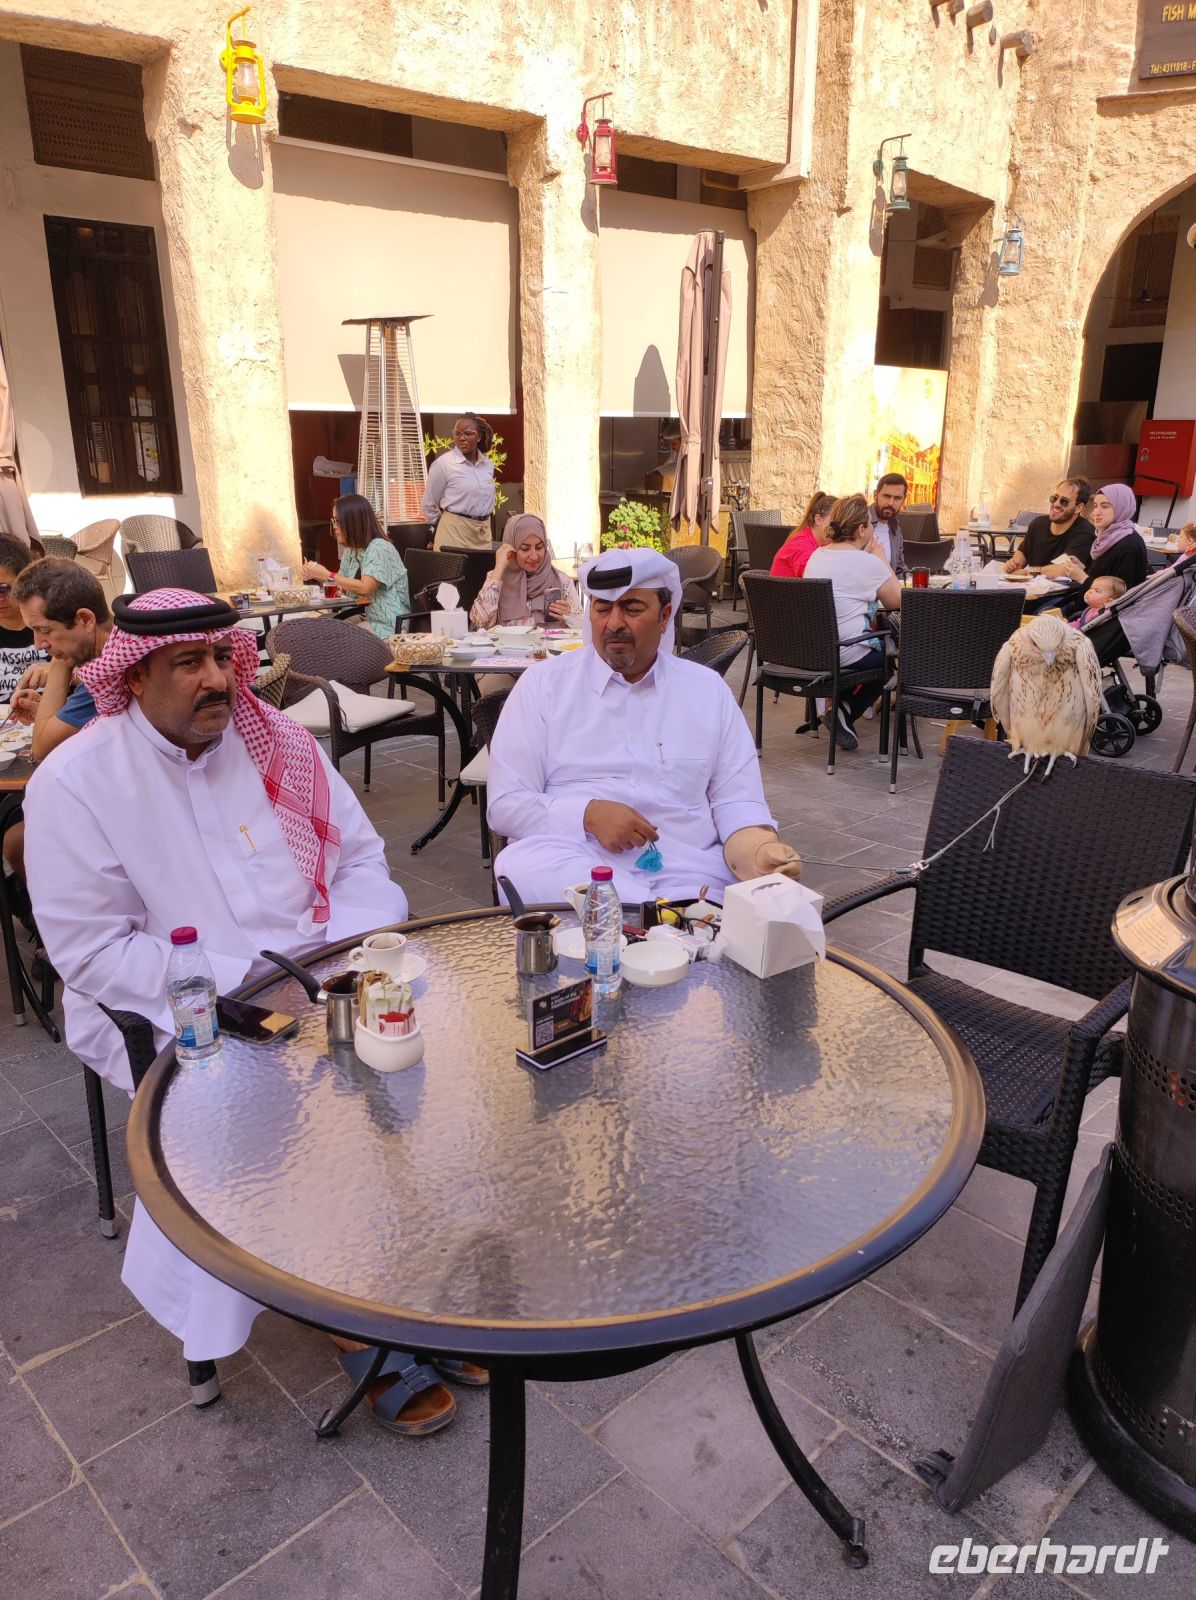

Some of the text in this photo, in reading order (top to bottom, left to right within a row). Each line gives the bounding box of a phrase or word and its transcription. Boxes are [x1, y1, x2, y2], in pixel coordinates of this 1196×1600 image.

[1162, 4, 1185, 22] FISH
[0, 650, 40, 666] ASSION
[4, 664, 31, 675] LOV
